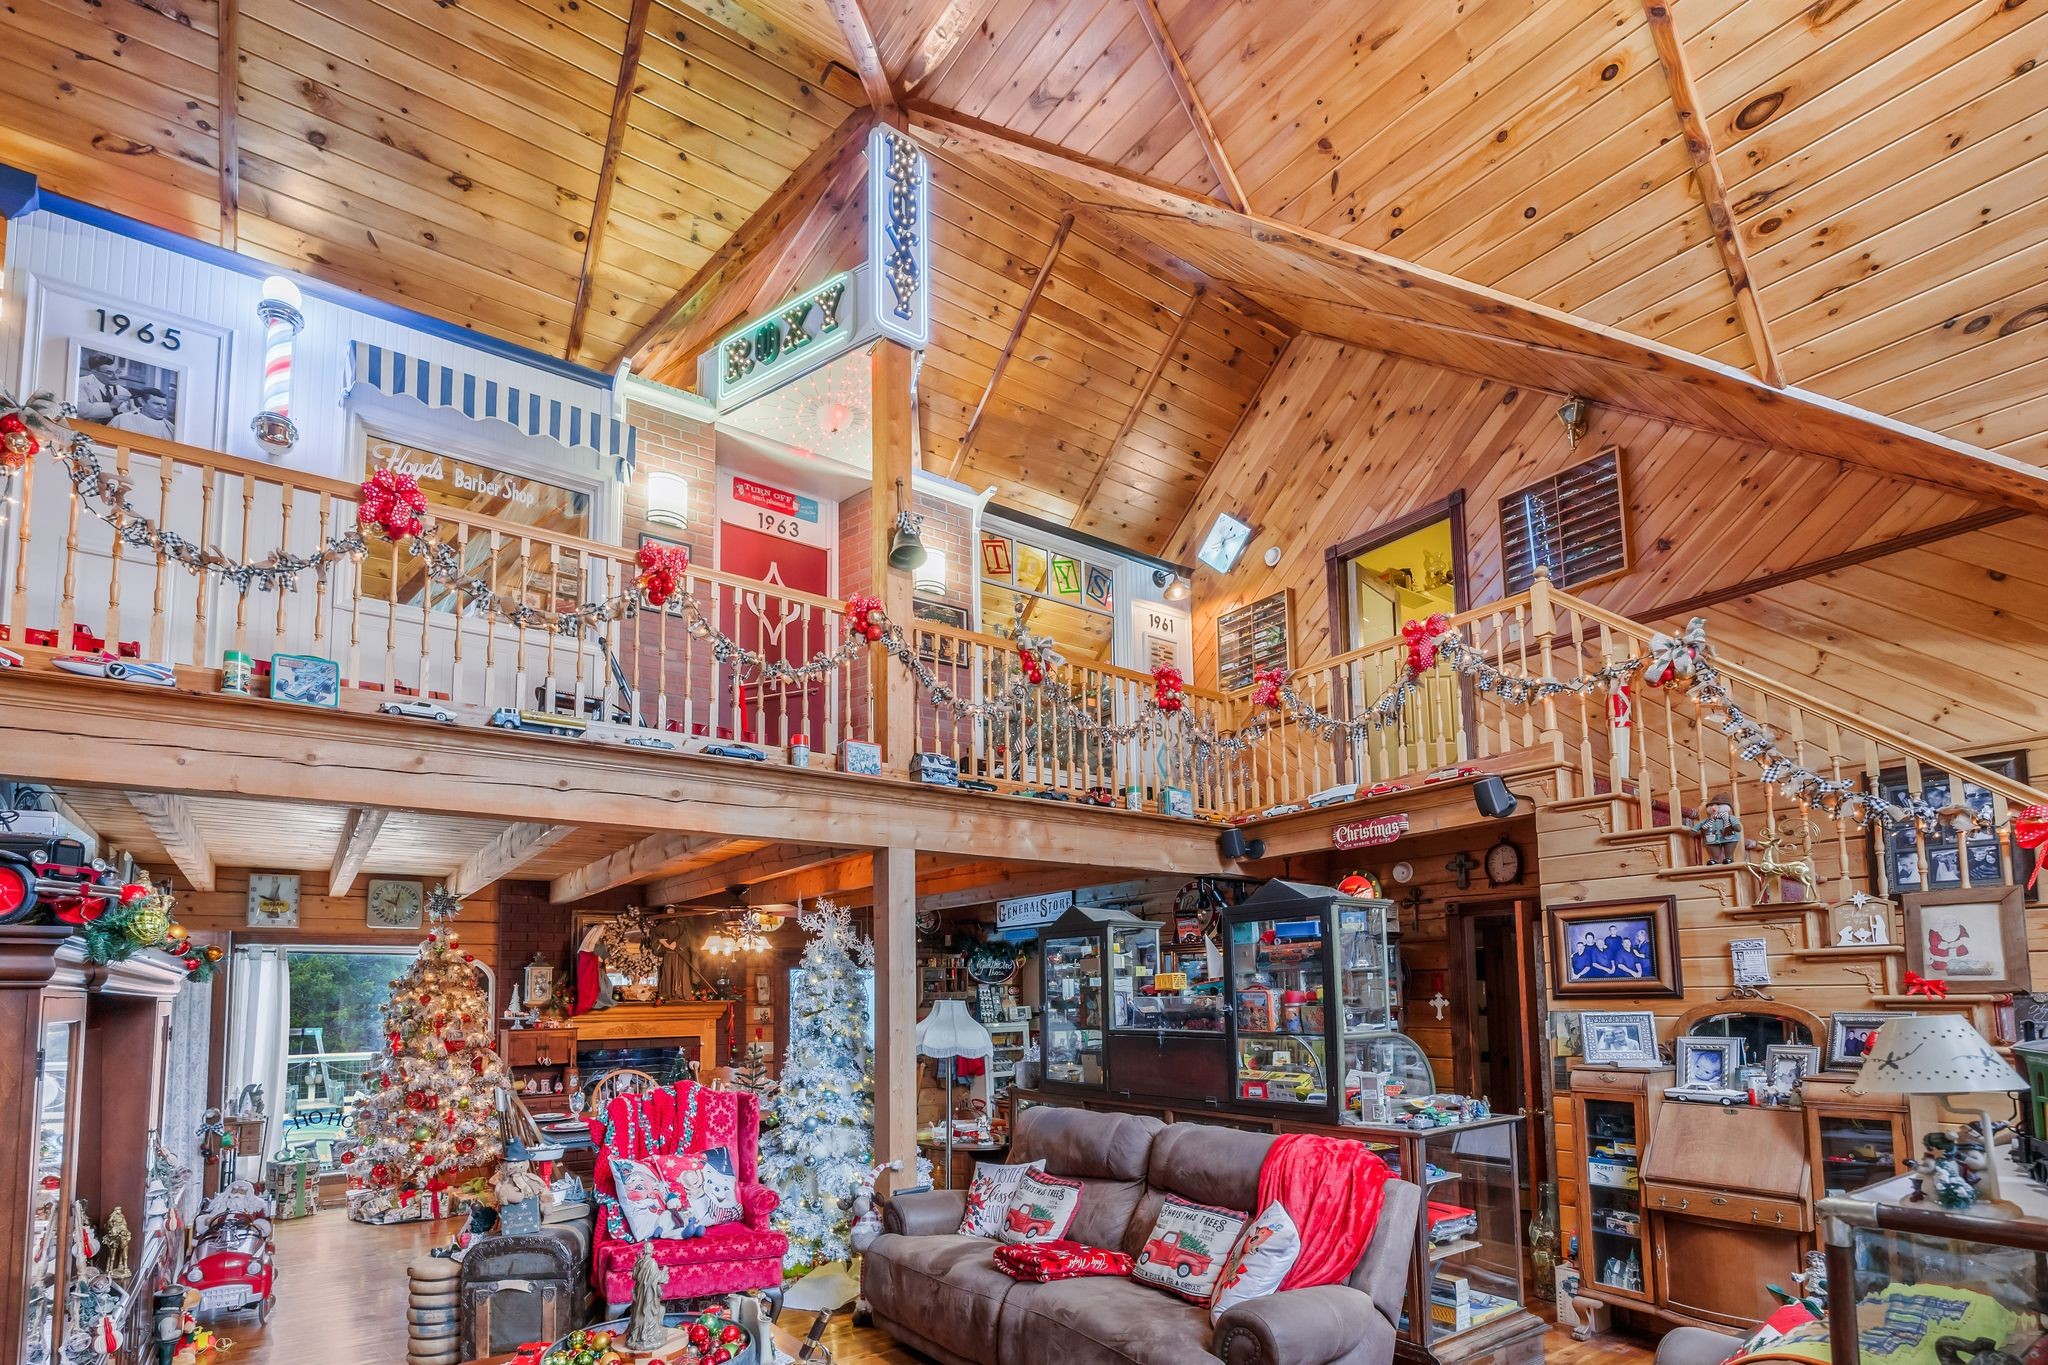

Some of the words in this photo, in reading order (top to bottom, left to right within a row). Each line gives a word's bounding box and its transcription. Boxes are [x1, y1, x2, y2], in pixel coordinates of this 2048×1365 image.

[884, 131, 922, 320] ROXY
[96, 308, 181, 351] 1965
[725, 281, 845, 384] ROXY
[454, 467, 501, 497] Barber
[502, 479, 534, 507] Shop
[744, 483, 770, 497] TURN
[773, 493, 793, 503] OFF
[758, 512, 800, 537] 1963
[1149, 614, 1173, 633] 1961
[112, 664, 124, 676] 7
[1336, 821, 1400, 844] Christmas
[998, 900, 1040, 922] GENERAL
[1040, 897, 1071, 917] STORE
[293, 1110, 323, 1129] HO
[328, 1112, 354, 1128] HO
[1160, 1205, 1199, 1221] CHRISTMAS
[1200, 1215, 1228, 1233] TREES
